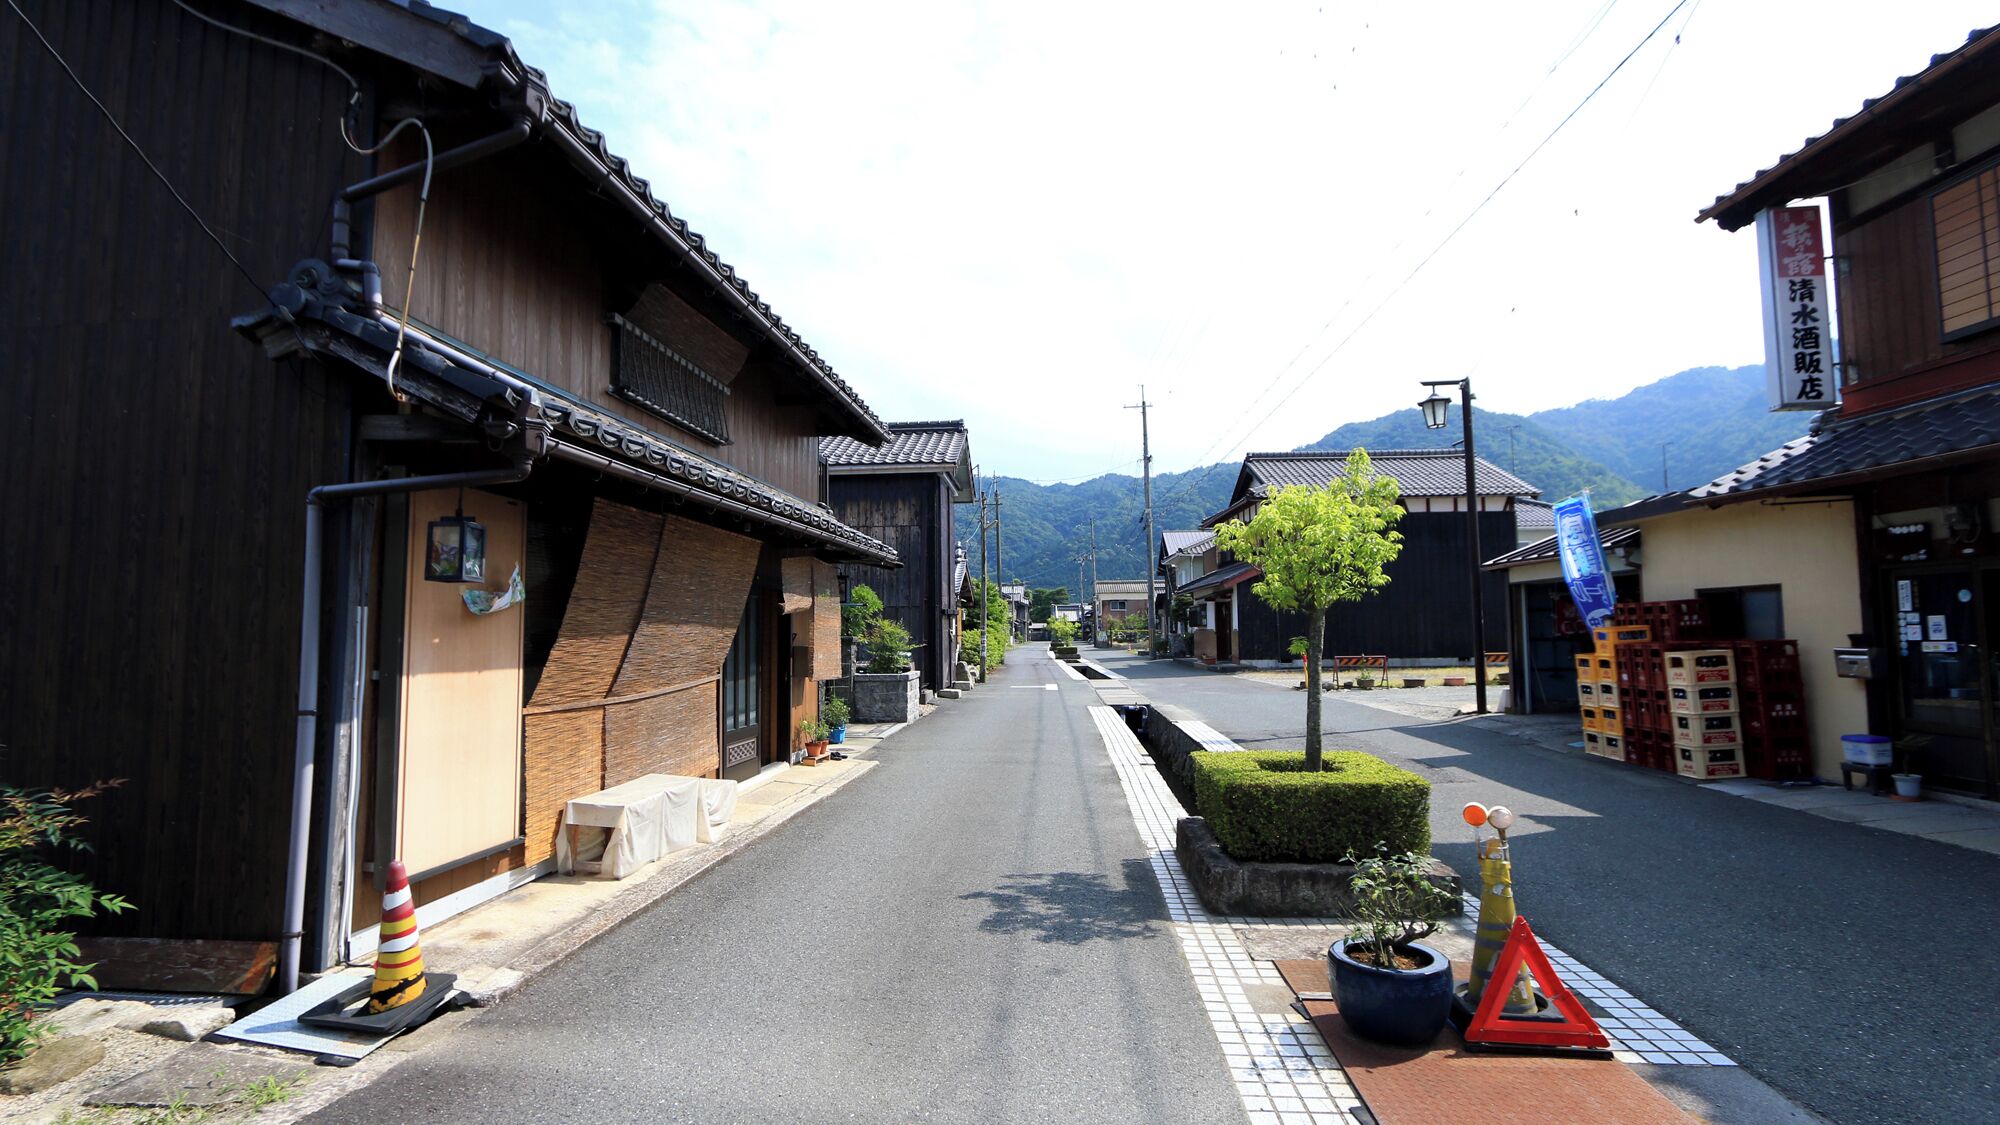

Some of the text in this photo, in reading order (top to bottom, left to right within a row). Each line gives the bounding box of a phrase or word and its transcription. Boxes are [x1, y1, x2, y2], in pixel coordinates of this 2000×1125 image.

[1788, 278, 1824, 400] 清水酒販店
